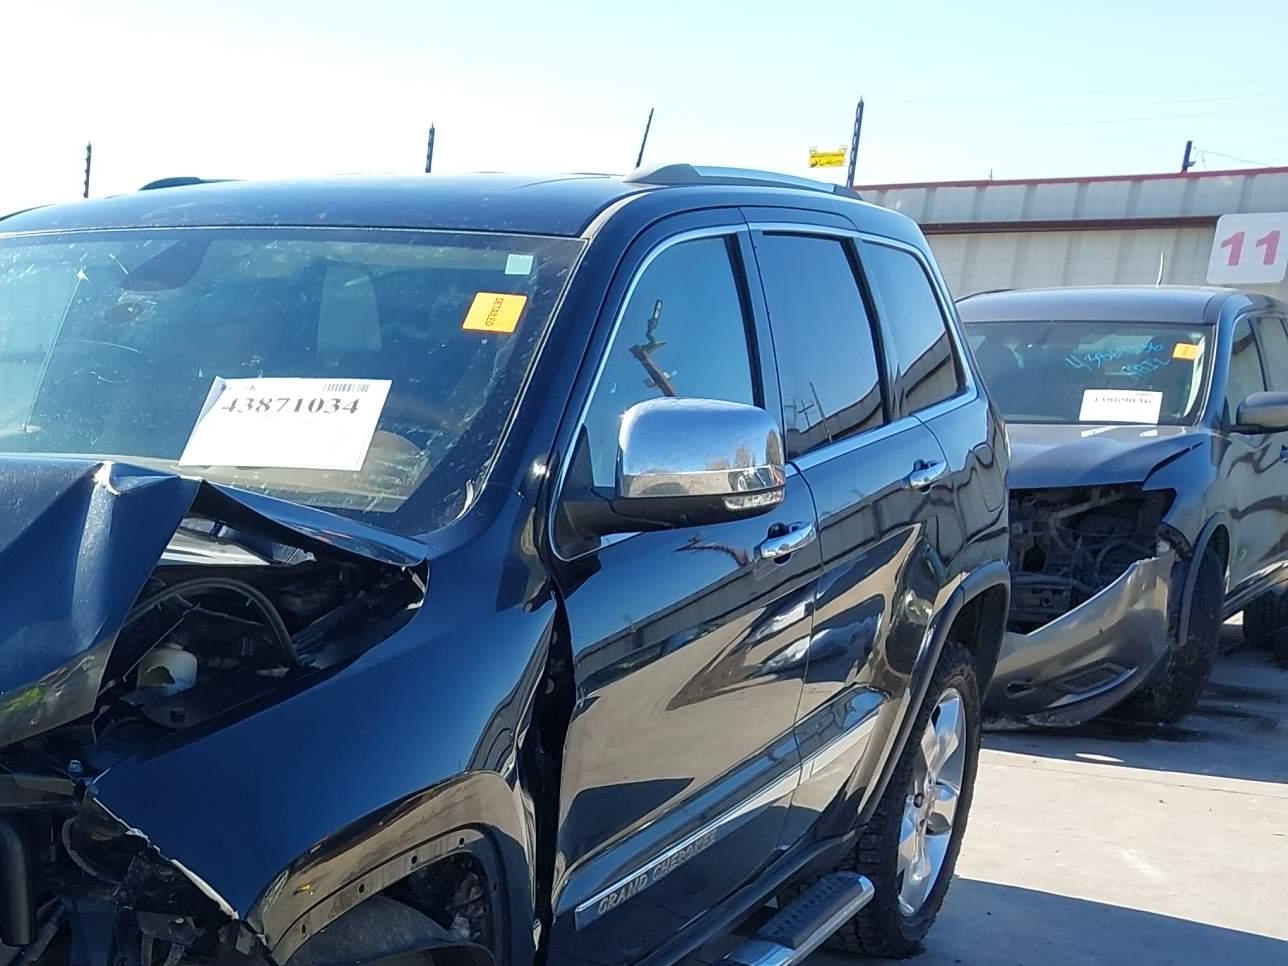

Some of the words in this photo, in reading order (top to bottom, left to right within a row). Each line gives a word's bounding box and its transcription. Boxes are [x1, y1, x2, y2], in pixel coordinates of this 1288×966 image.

[1220, 230, 1281, 266] 11
[485, 297, 504, 327] DETAILED
[222, 397, 360, 414] 43871034
[597, 873, 648, 915] GRAND
[651, 828, 718, 881] CHEROKEE
